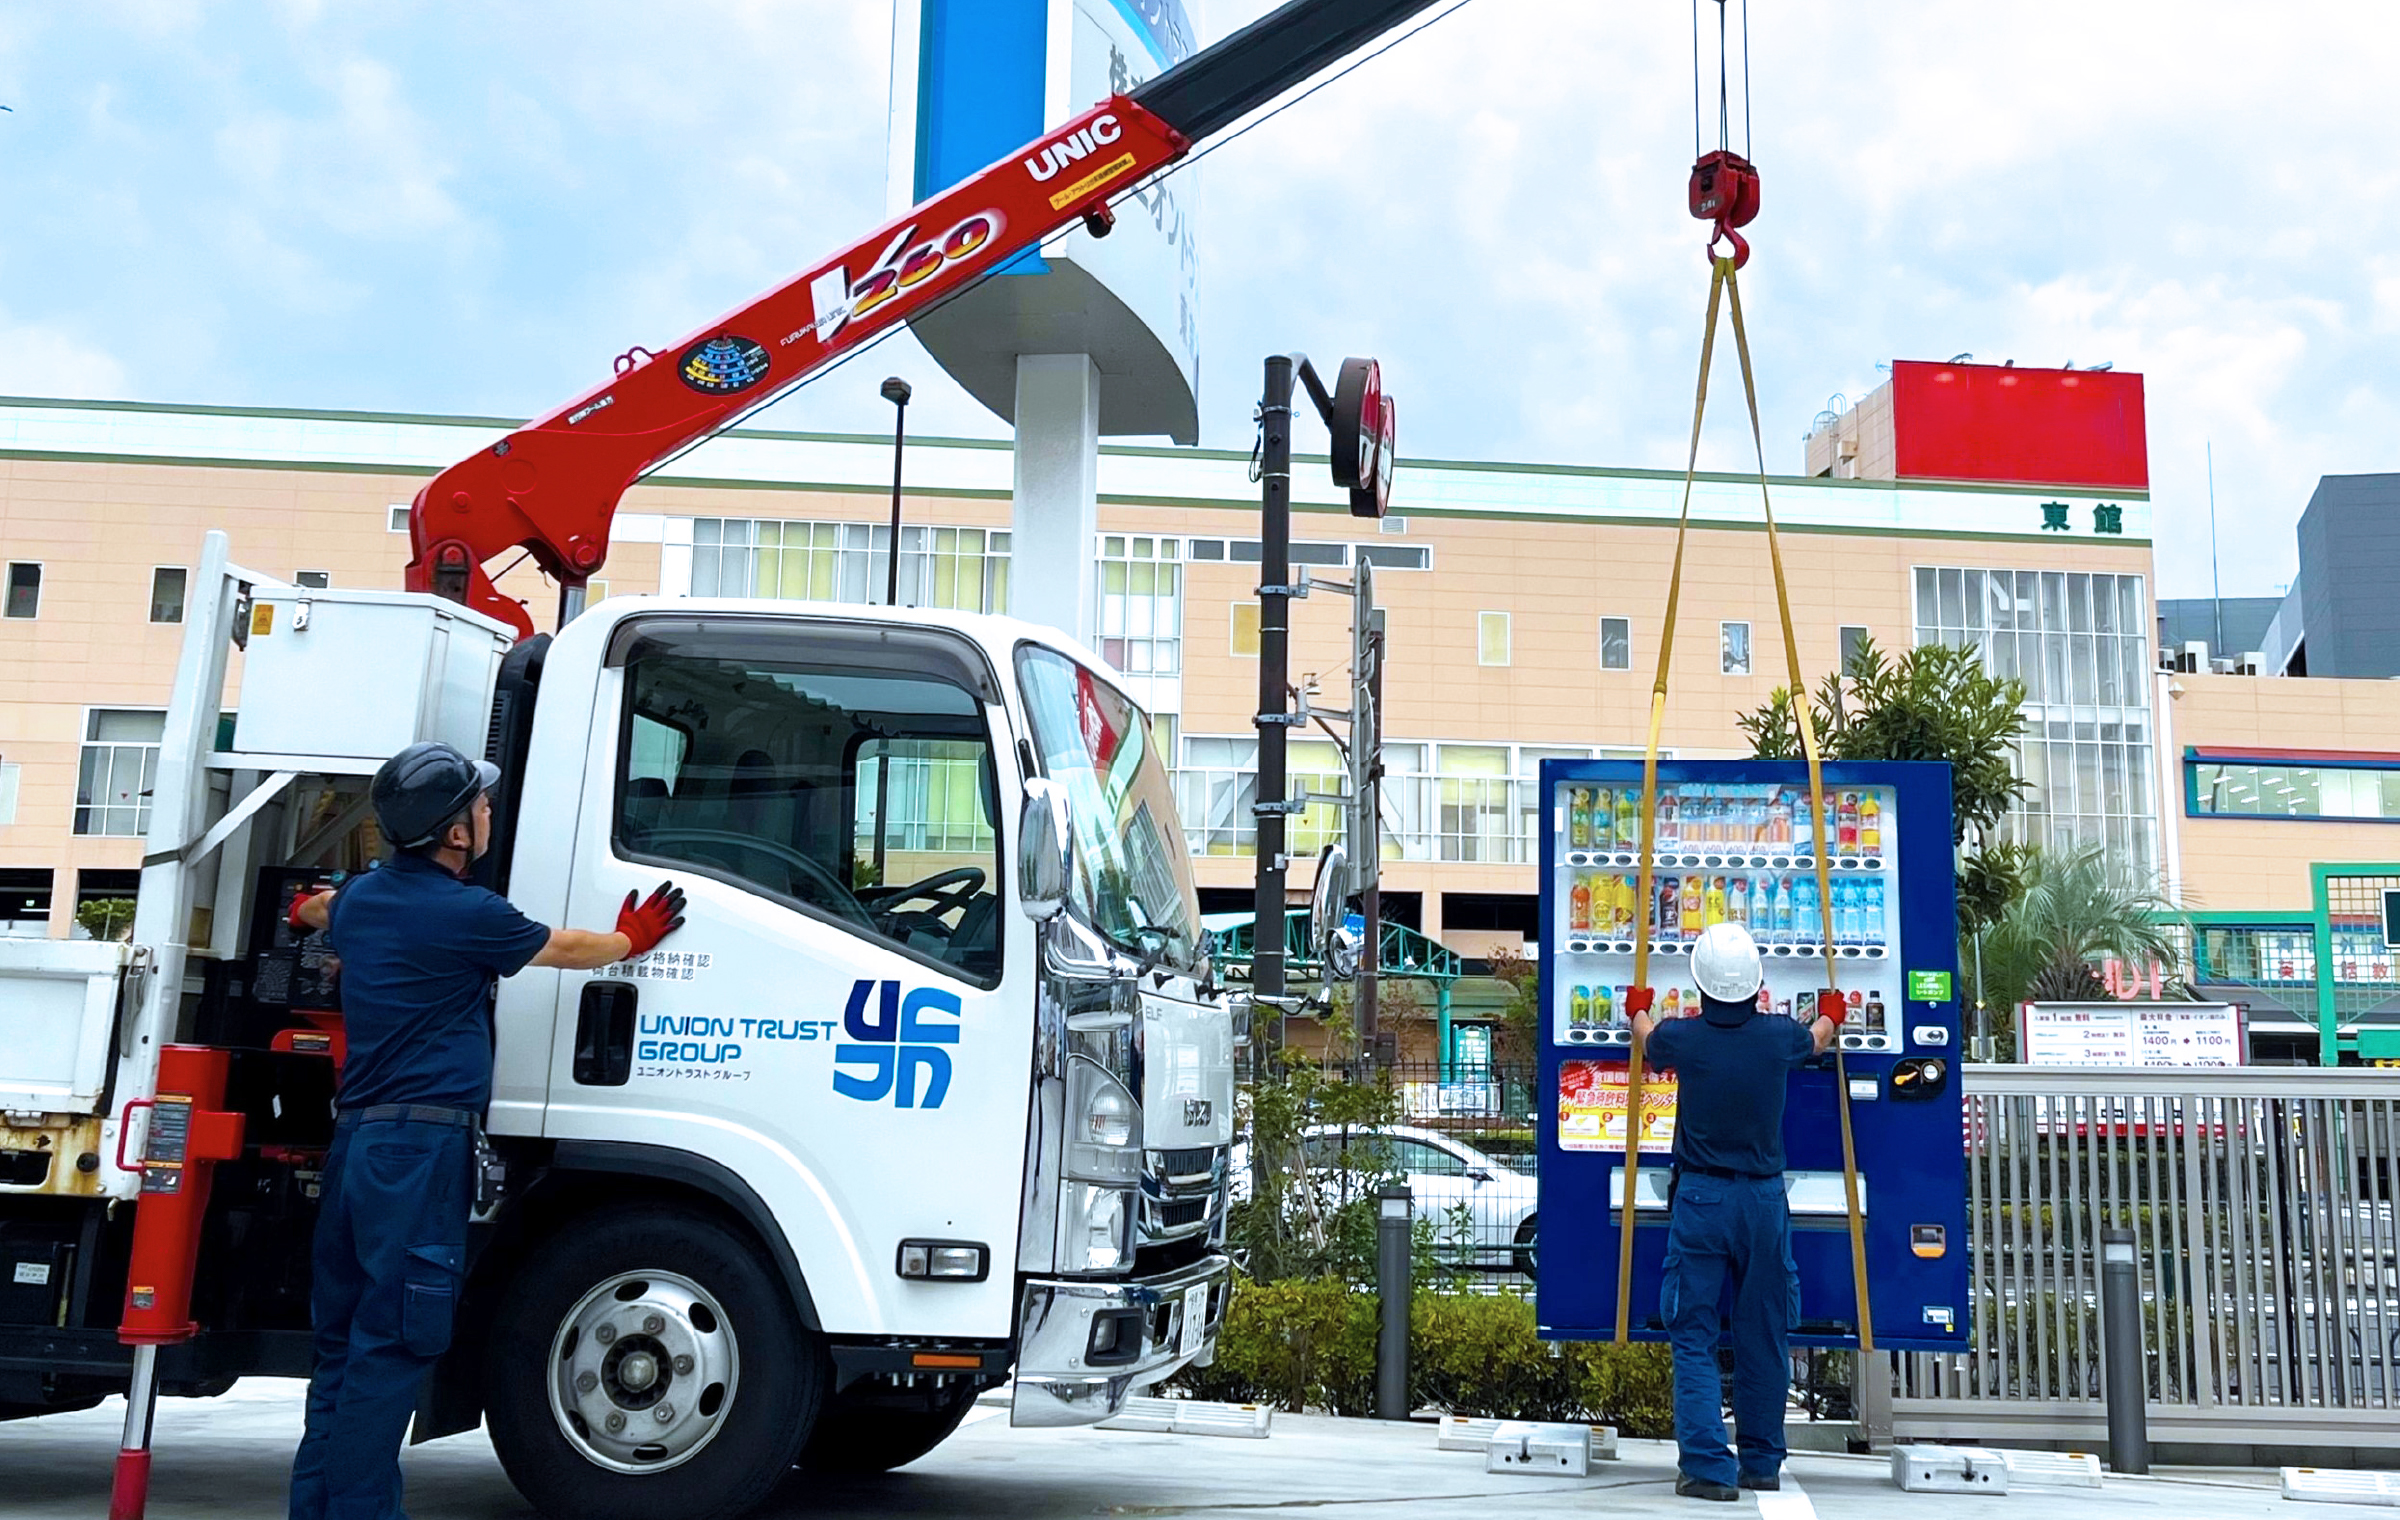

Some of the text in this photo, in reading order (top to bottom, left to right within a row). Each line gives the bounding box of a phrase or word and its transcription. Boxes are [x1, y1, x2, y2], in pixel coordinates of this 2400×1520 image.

[1024, 114, 1122, 182] UNIC
[2040, 500, 2123, 535] 東館
[1145, 1005, 1162, 1021] ELF
[640, 1015, 838, 1041] UNION TRUST
[2142, 1036, 2169, 1045] 1400
[2196, 1036, 2223, 1046] 1100
[638, 1040, 742, 1063] GROUP
[636, 1066, 751, 1081] ユニオントラストグループ
